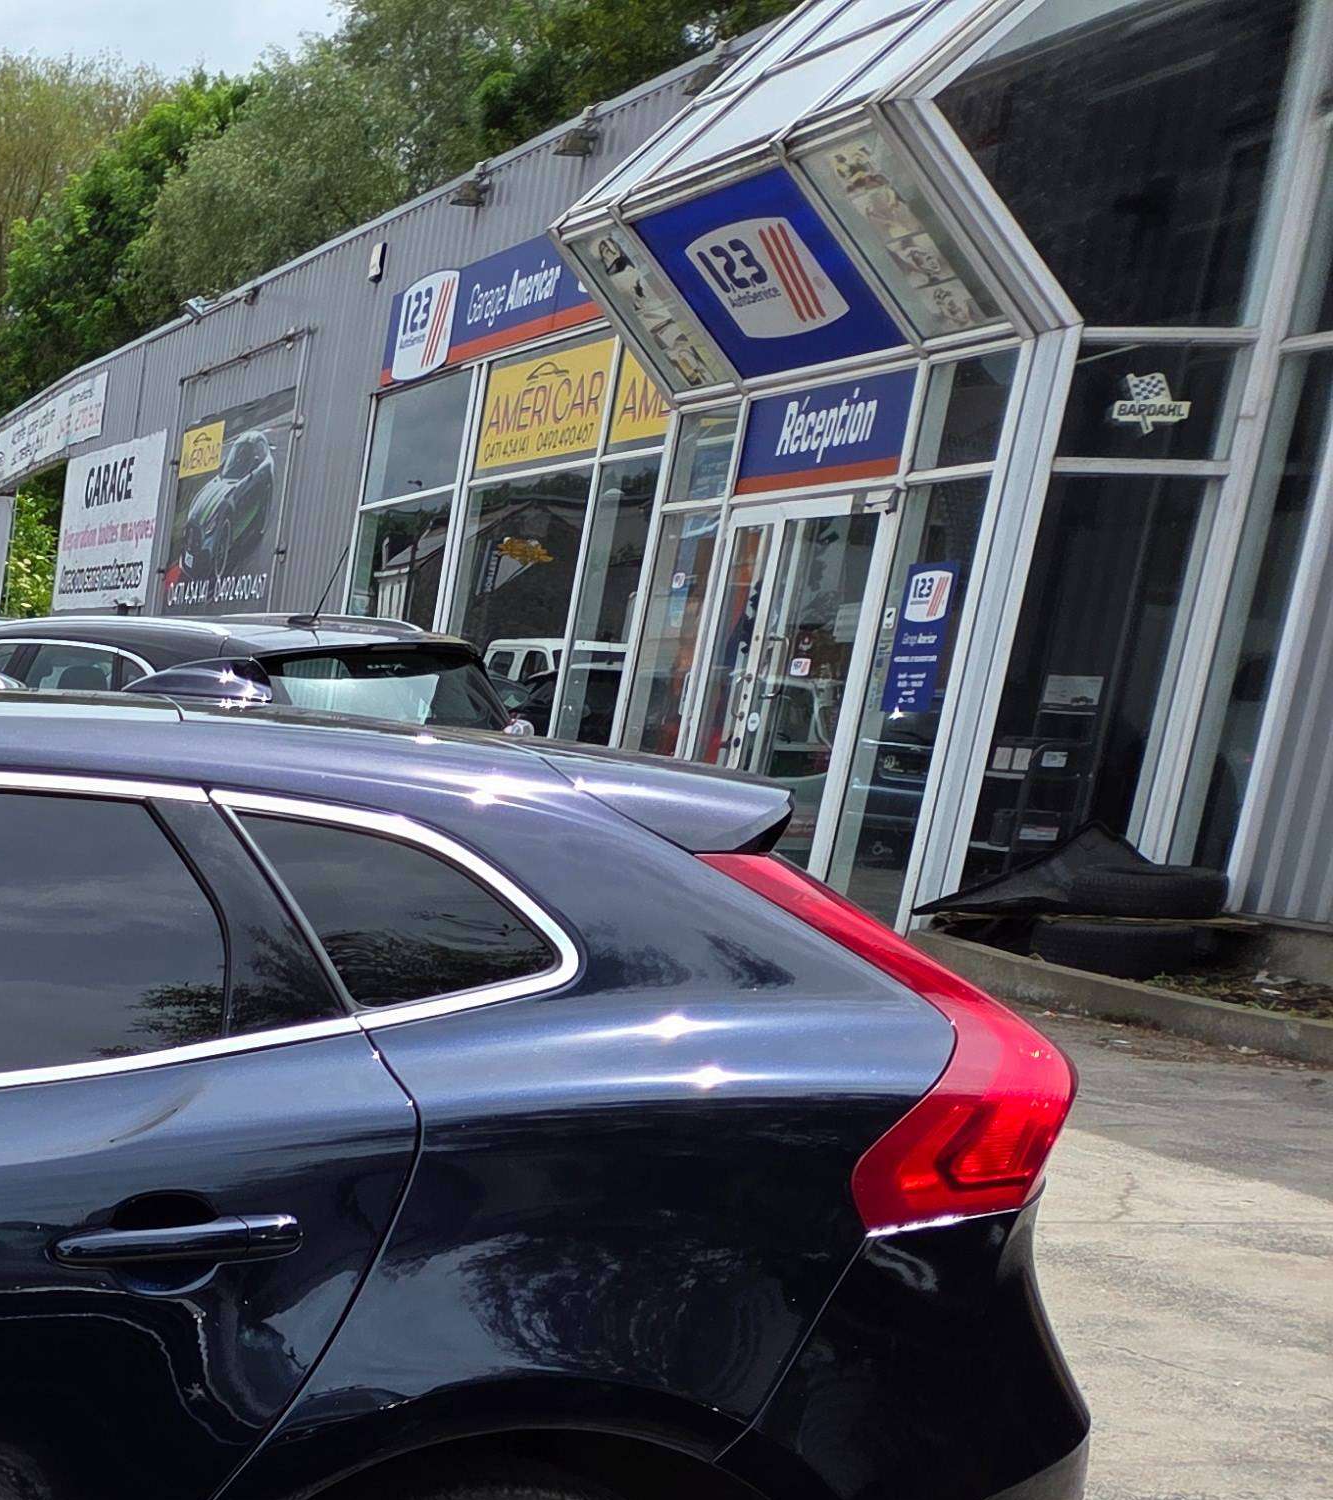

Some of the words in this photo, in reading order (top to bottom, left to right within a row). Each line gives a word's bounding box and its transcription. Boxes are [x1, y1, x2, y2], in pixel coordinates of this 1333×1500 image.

[466, 283, 507, 328] Garage
[504, 259, 562, 313] Americar
[775, 386, 878, 464] Réception
[85, 456, 135, 509] GARAGE
